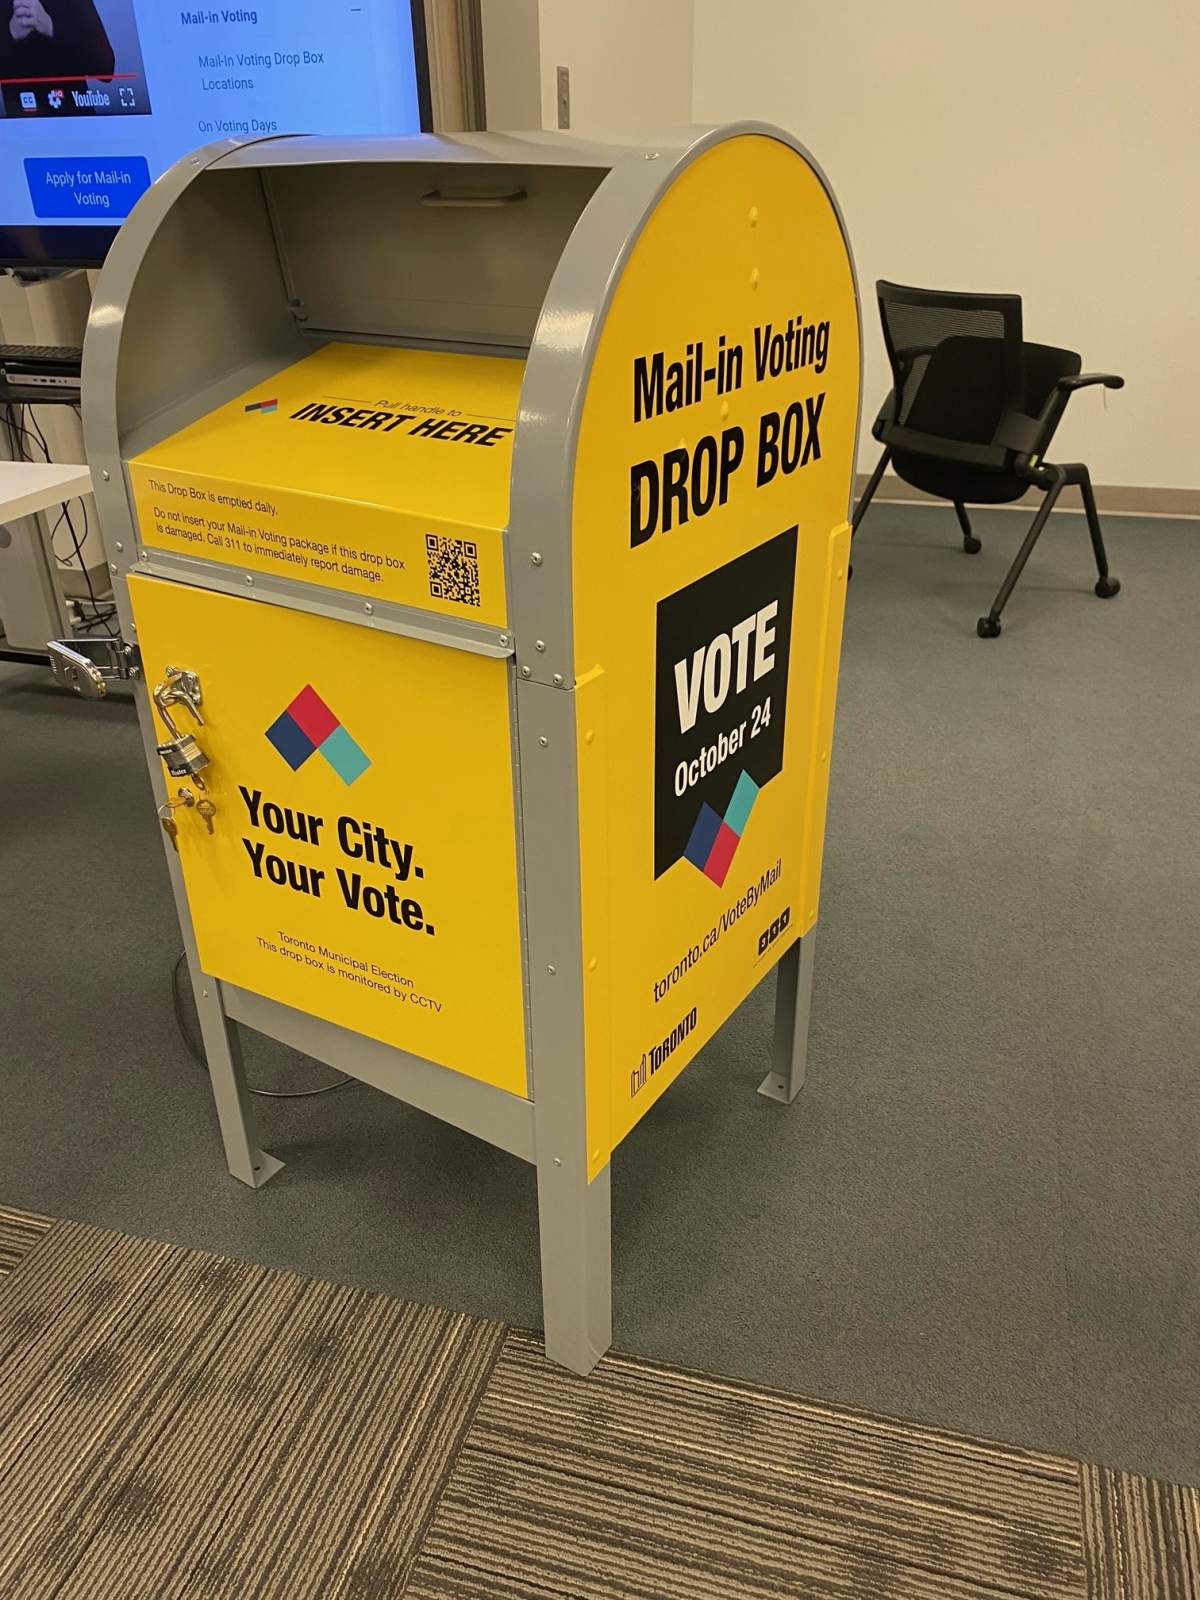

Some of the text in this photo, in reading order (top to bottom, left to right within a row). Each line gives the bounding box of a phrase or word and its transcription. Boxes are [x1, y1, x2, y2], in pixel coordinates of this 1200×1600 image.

[181, 9, 258, 25] Mail-in Voting
[202, 77, 254, 91] Locations
[238, 52, 271, 68] Voting
[274, 52, 300, 67] Drop
[303, 50, 324, 65] Box
[72, 90, 110, 107] YouTube
[198, 118, 277, 134] On Voting Days
[45, 170, 131, 188] Apply for Mail-in
[74, 191, 110, 208] Voting
[633, 315, 830, 424] Mail-in Voting
[289, 403, 513, 447] INSERT HERE
[374, 399, 462, 417] Pull handle to
[149, 479, 278, 516] This Drop Box is emptied daily.
[630, 392, 826, 549] DROP BOX
[154, 507, 406, 570] Do not insert your Mail-in Voting package if this drop box
[156, 523, 384, 583] is damaged. Call 311 to immediately report damage.
[674, 599, 779, 735] VOTE
[674, 696, 771, 797] October 24
[238, 784, 425, 882] Your City.
[242, 838, 435, 936] Your Vote.
[278, 930, 414, 988] Toronto Municipal Election
[653, 858, 782, 1003] toronto.ca/VoteByMail
[256, 936, 442, 1013] This drop box is monitored by CCTV
[648, 1006, 697, 1077] TORONTO
